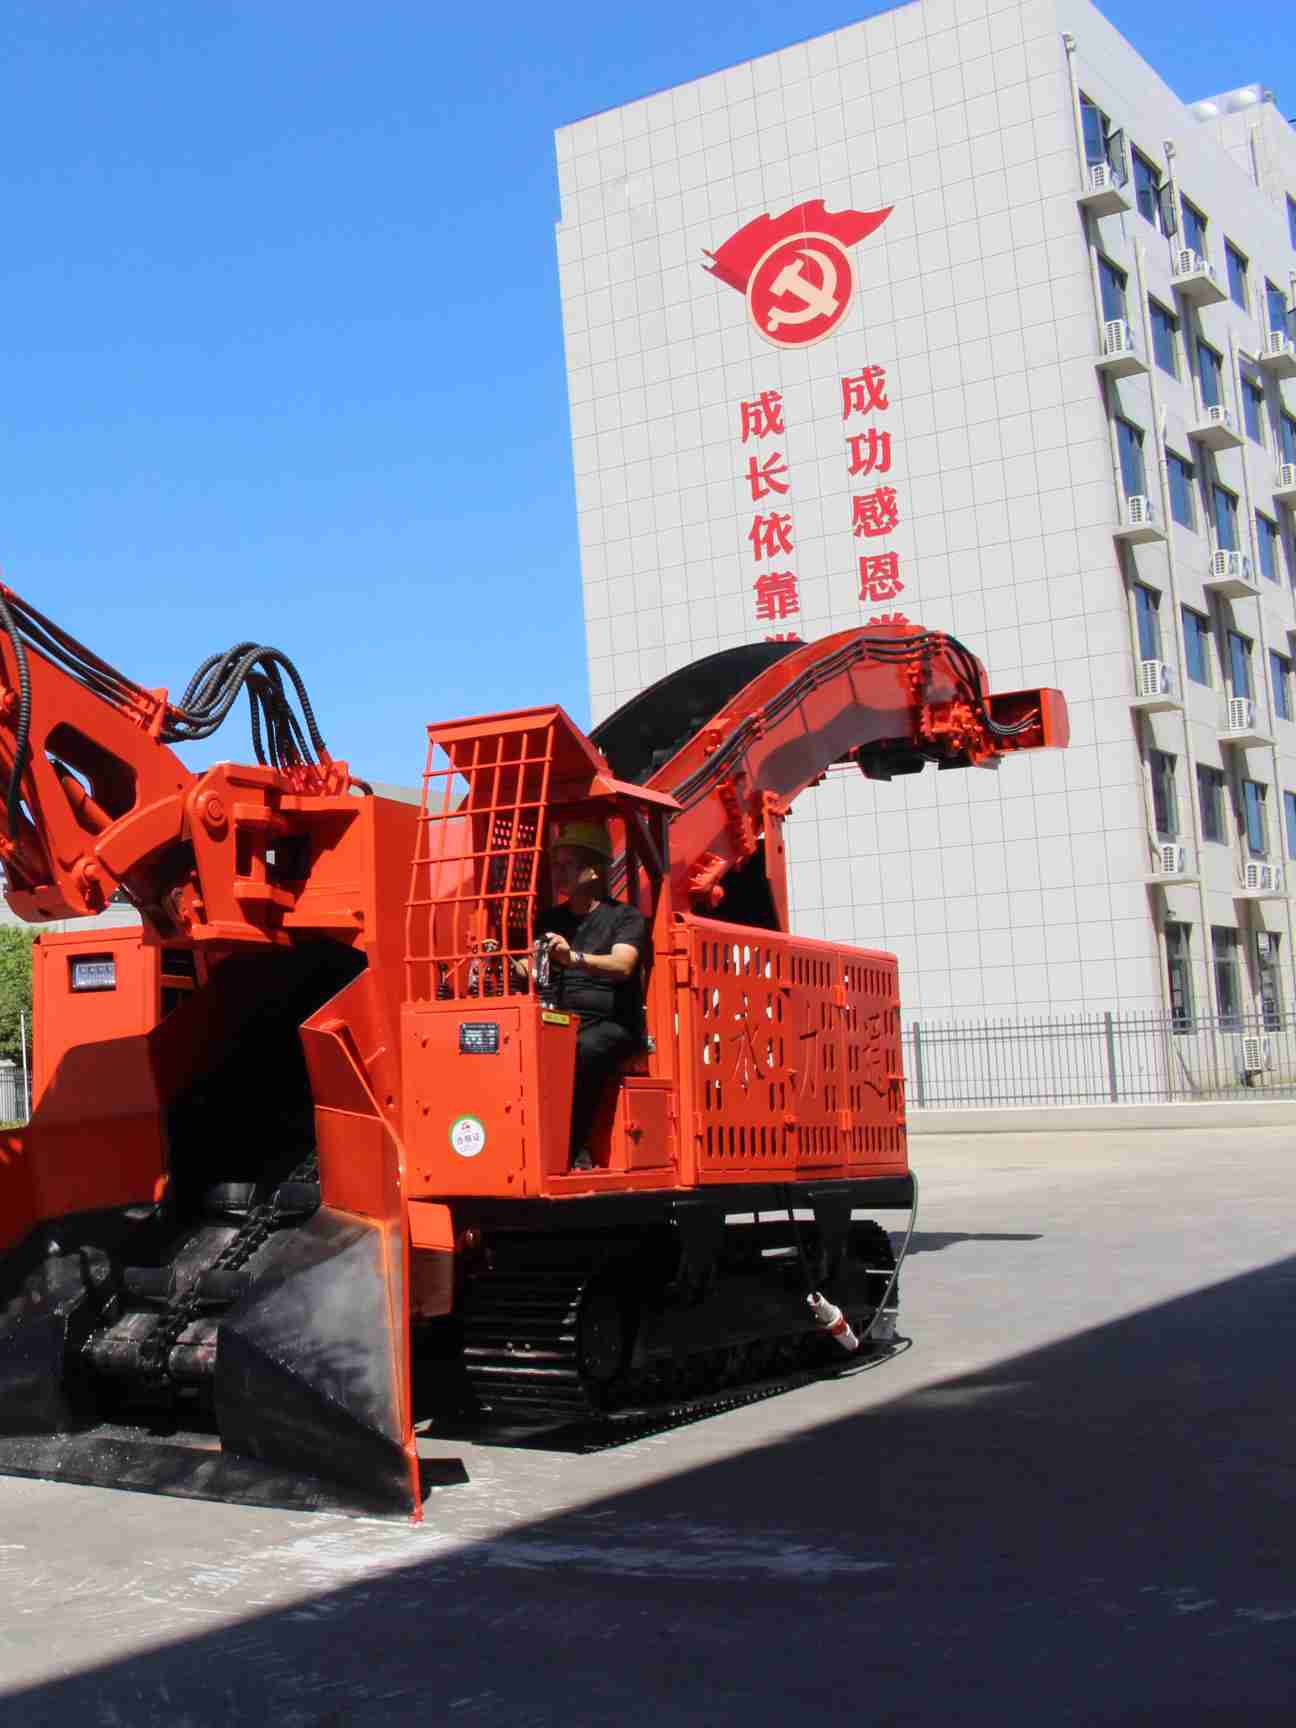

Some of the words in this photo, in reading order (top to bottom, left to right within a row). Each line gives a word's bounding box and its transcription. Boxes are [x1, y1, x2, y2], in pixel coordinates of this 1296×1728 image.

[740, 390, 802, 642] 成长依靠
[841, 365, 910, 625] 成功感恩
